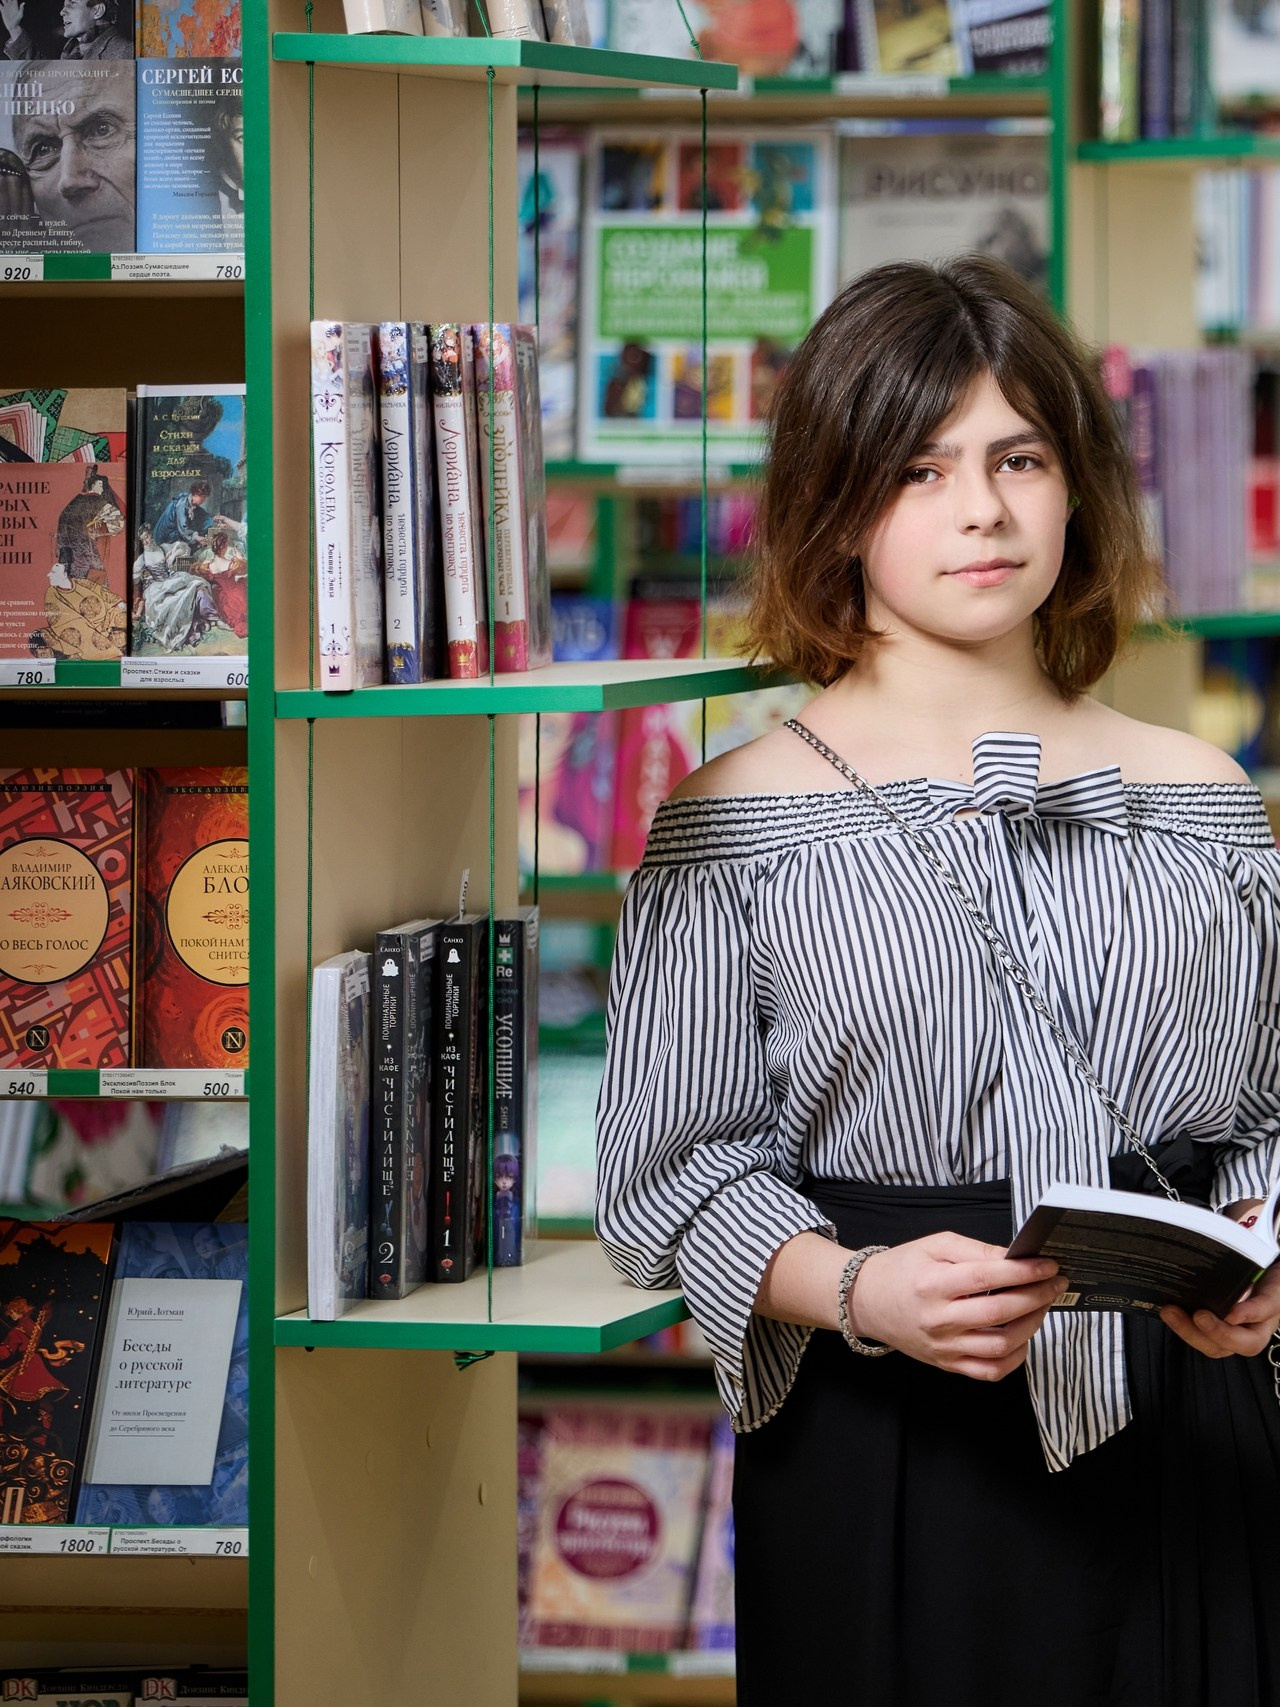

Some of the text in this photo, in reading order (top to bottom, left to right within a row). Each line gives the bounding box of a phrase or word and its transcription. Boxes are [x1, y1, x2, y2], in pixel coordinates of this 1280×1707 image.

[142, 65, 213, 85] СЕРГЕЙ
[0, 80, 43, 97] НИЙ
[12, 229, 47, 237] Древнему
[48, 228, 76, 237] Египту.
[5, 267, 31, 279] 920
[216, 266, 241, 278] 780
[160, 430, 193, 439] Стихи
[167, 457, 186, 465] для
[151, 469, 201, 479] взрослых
[331, 623, 336, 634] 1
[394, 618, 401, 630] 2
[17, 671, 43, 684] 780
[12, 864, 72, 873] ВЛАДИМИР
[203, 876, 249, 893] БЛО
[13, 940, 43, 950] ВЕСЬ
[46, 940, 89, 950] ГОЛОС
[180, 938, 244, 947] ПОКОЙ НАМ
[496, 967, 512, 977] Re
[445, 974, 453, 1029] ПОМИНАЛЬНЫЕ
[382, 984, 390, 1040] ПОМИНАЛЬНЫЕ
[389, 996, 397, 1028] ТОРТИКИ
[496, 1013, 512, 1099] УСОПШИЕ
[8, 1082, 35, 1095] 540
[203, 1083, 229, 1095] 500
[443, 1229, 451, 1247] 1
[379, 1242, 394, 1264] 2
[128, 1307, 184, 1317] Юрий Лотман
[123, 1339, 172, 1353] Беседы
[119, 1358, 183, 1374] о русской
[115, 1380, 192, 1393] литературе
[60, 1539, 94, 1552] 1800
[215, 1542, 242, 1554] 780
[6, 1680, 34, 1697] DK
[145, 1680, 173, 1697] DK
